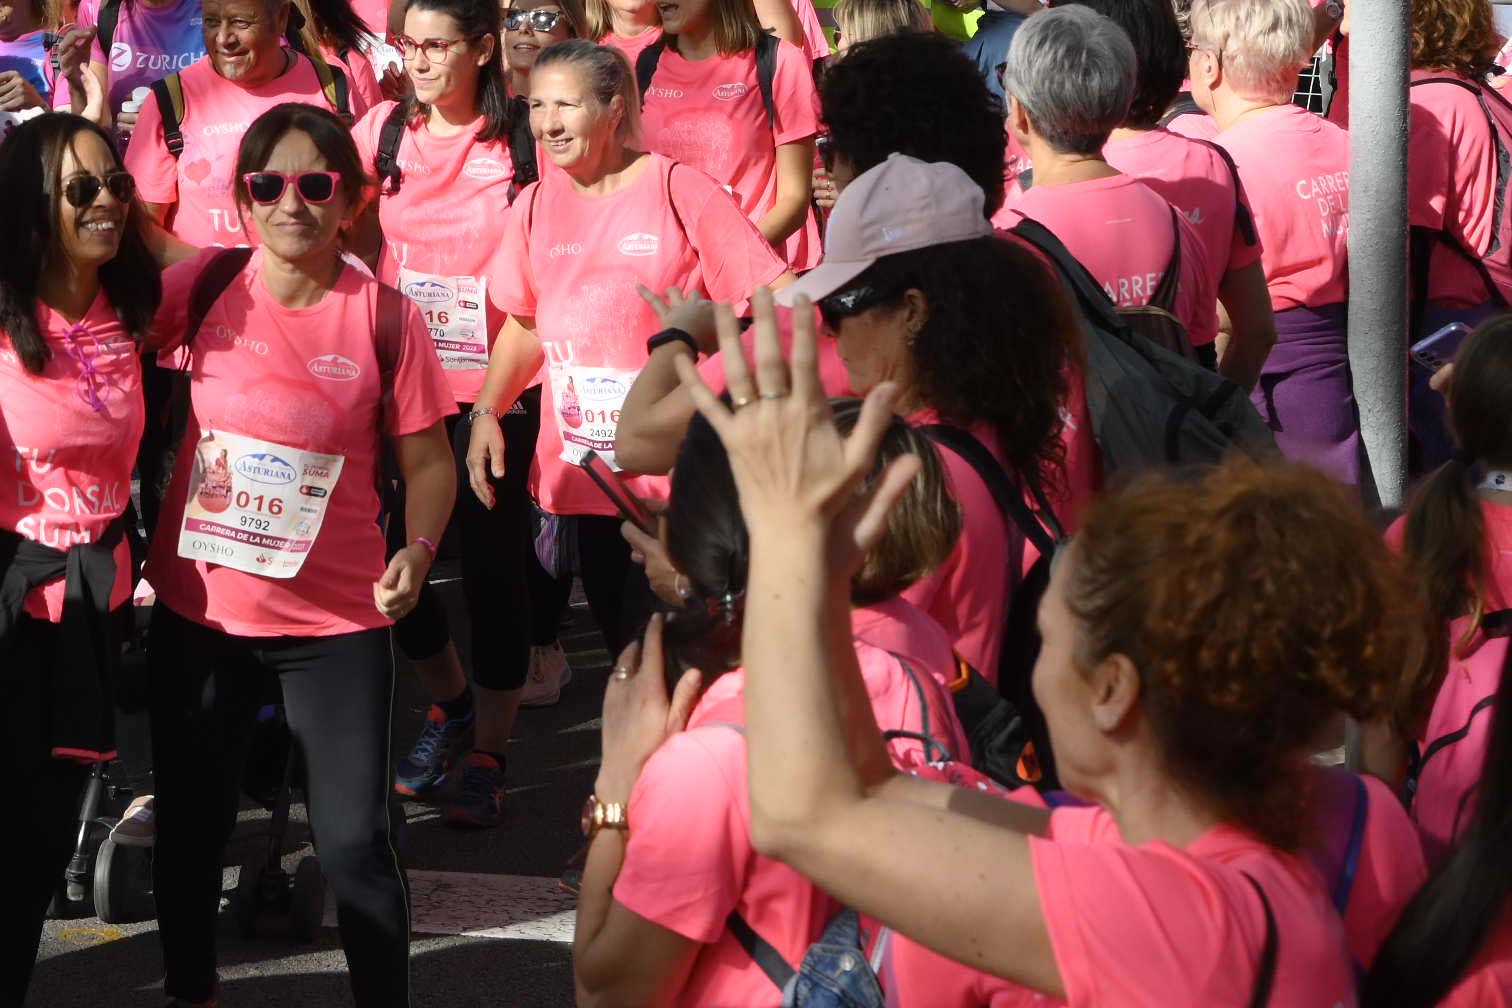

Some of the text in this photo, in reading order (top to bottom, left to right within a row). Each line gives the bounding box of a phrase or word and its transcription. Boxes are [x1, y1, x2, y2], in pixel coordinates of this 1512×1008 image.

[136, 51, 204, 71] ZURICH
[209, 208, 241, 233] TU
[407, 289, 450, 299] ASTURIANA
[425, 310, 449, 324] 16
[310, 362, 359, 378] ASTURIANA
[590, 428, 616, 438] 2492
[14, 447, 55, 473] TU
[239, 462, 293, 481] ASTURIANA
[19, 484, 121, 514] DORSAL
[236, 489, 283, 516] 016
[199, 522, 236, 540] CARRERA
[236, 531, 248, 542] DE
[250, 534, 260, 544] LA
[240, 515, 270, 532] 9792
[192, 539, 234, 557] OYSHO
